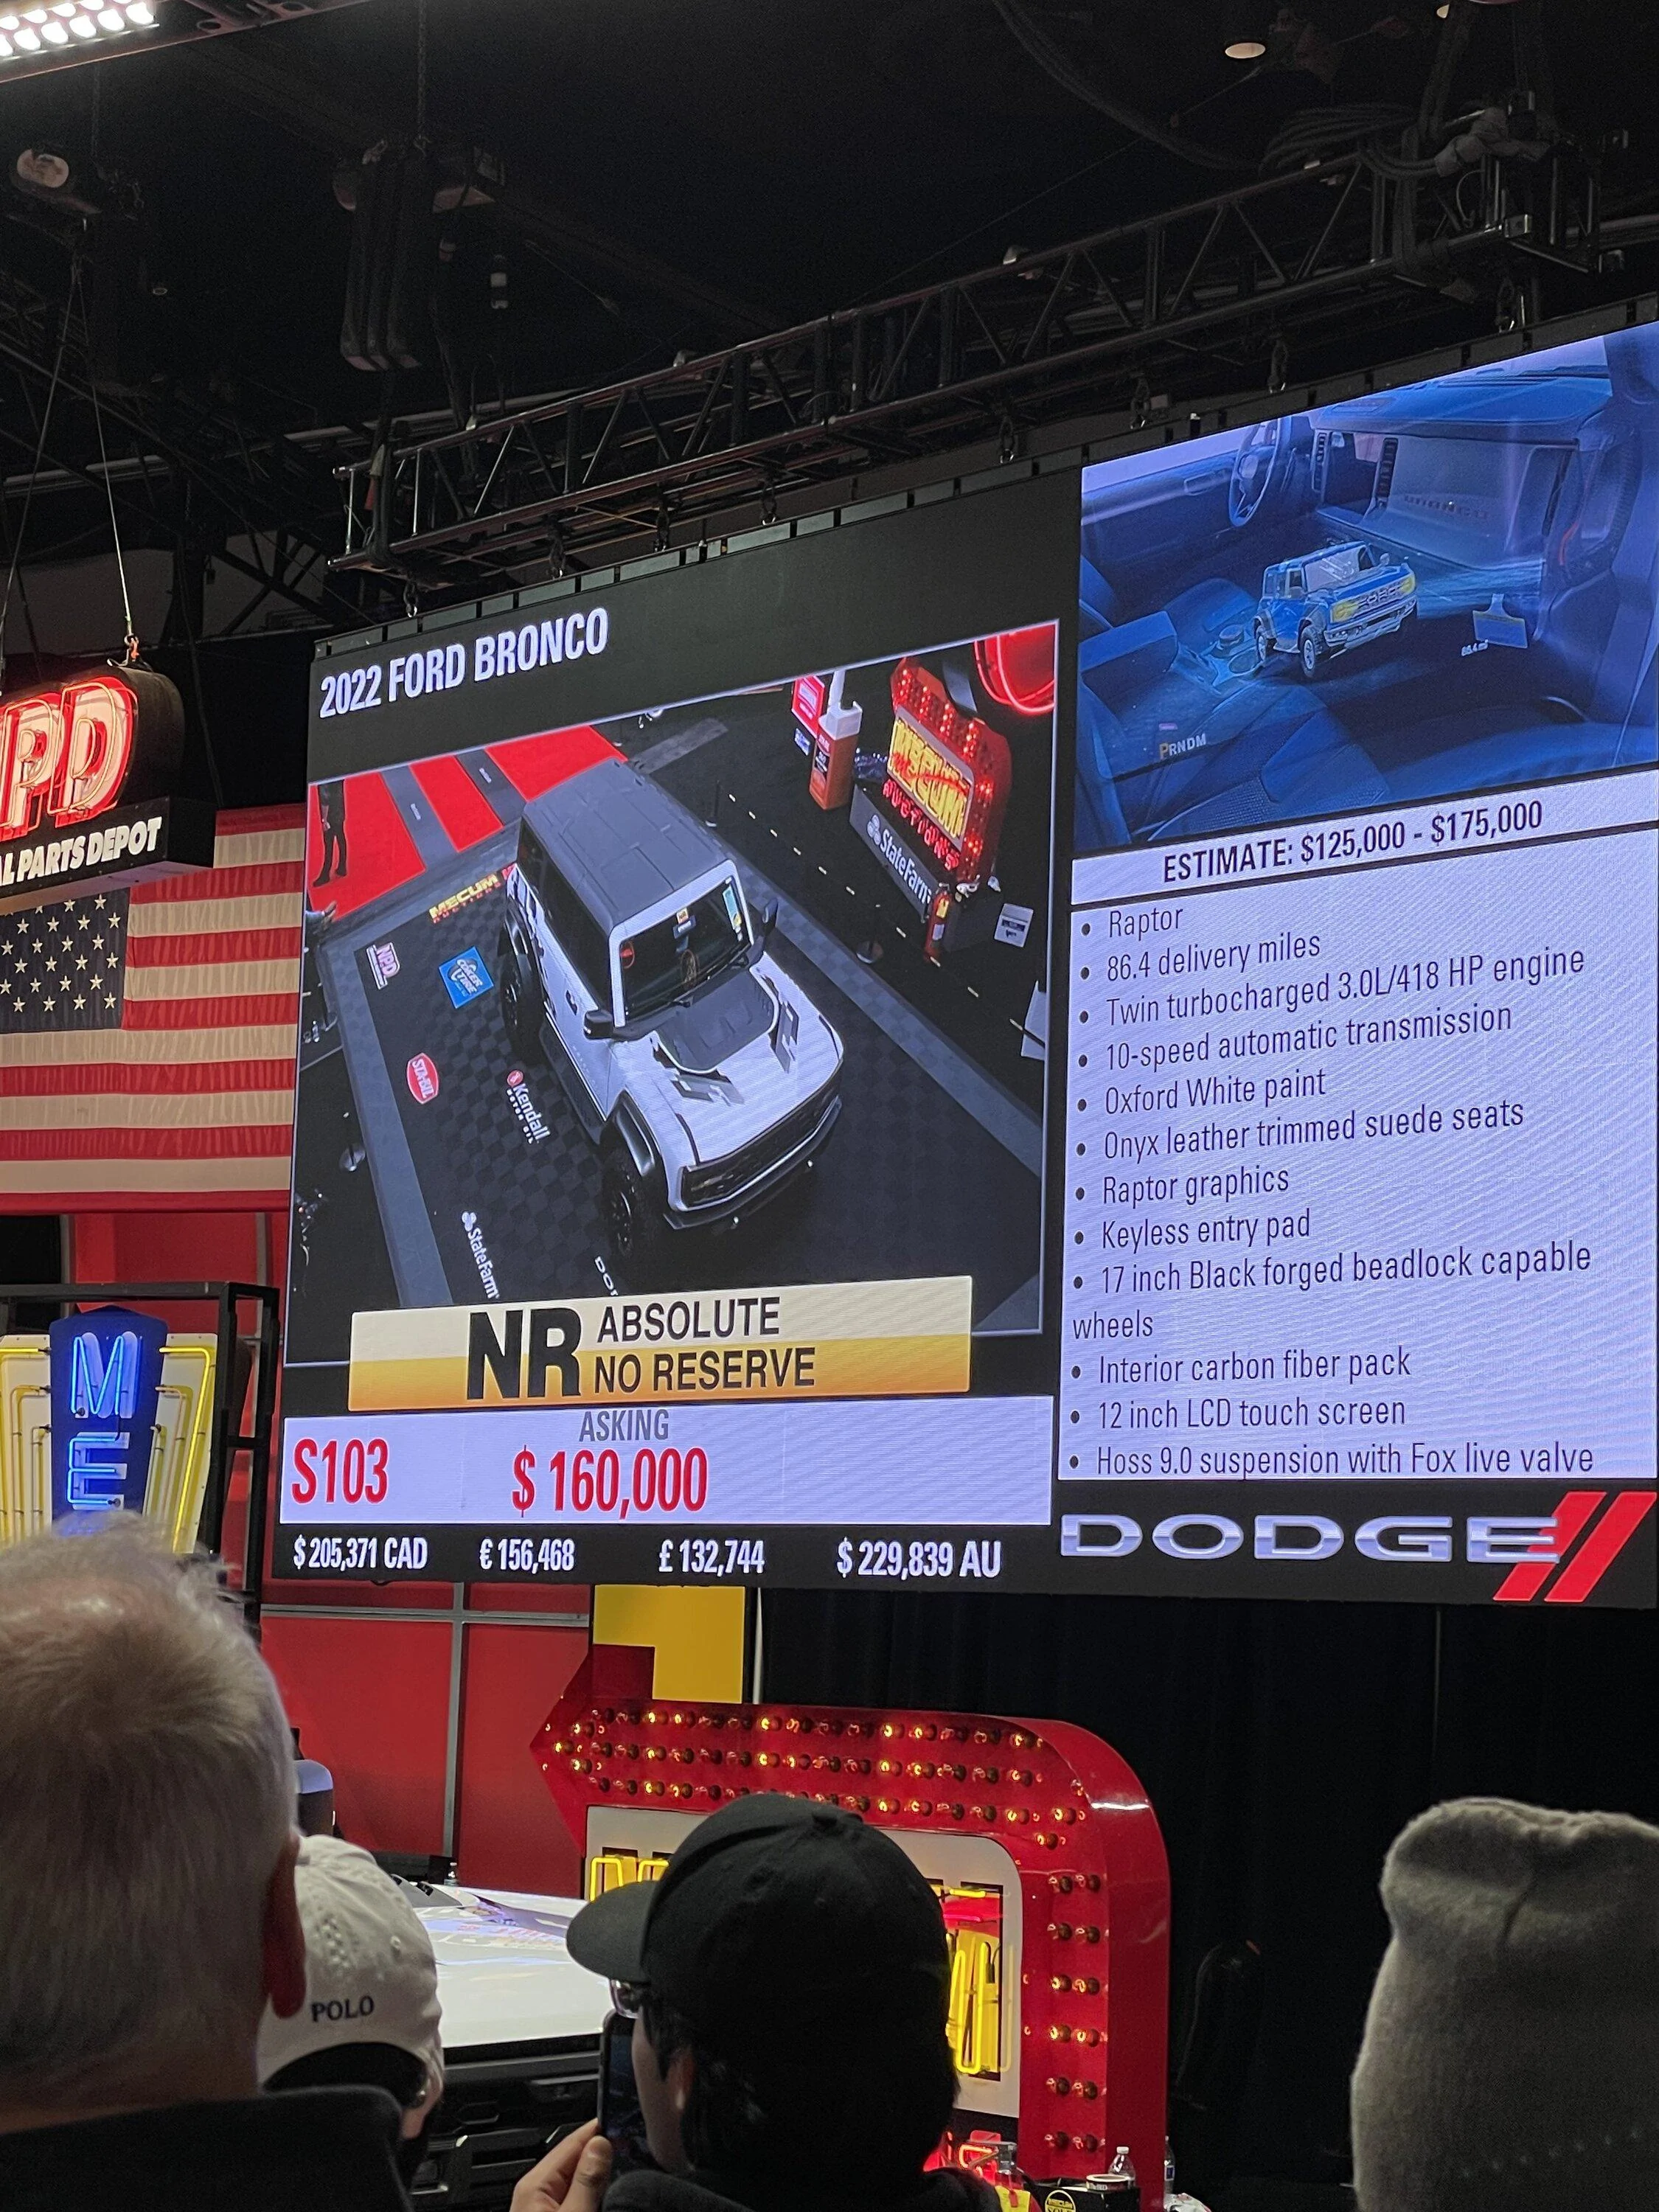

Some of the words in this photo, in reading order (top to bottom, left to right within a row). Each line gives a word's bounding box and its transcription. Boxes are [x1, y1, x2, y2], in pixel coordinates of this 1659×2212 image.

[319, 664, 382, 718] 2022
[389, 643, 466, 702] FORD
[474, 608, 608, 682] BRONCO
[1159, 733, 1206, 760] PRNDM
[16, 835, 86, 883] PARTS
[86, 816, 162, 866] DEPOT
[1164, 838, 1293, 883] ESTIMATE:
[1301, 821, 1405, 865] $125,000
[1430, 800, 1543, 846] $175,000
[429, 874, 498, 919] MECUM
[1109, 908, 1183, 942] Raptor
[1107, 951, 1150, 982] 86.4
[1158, 942, 1251, 977] delivery
[1259, 931, 1321, 964] miles
[1106, 995, 1159, 1026] Twin
[1166, 973, 1329, 1019] turbocharged
[1338, 961, 1439, 1000] 3.0L/418
[1450, 954, 1484, 987] HP
[1493, 946, 1585, 986] engine
[1107, 1032, 1209, 1073] 10-speed
[1218, 1020, 1338, 1059] automatic
[1346, 1002, 1511, 1046] transmission
[512, 1083, 551, 1140] Kendall
[1105, 1080, 1178, 1115] Oxford
[1186, 1075, 1256, 1107] White
[1265, 1068, 1326, 1108] paint
[1105, 1131, 1159, 1164] Onyx
[1167, 1122, 1251, 1155] leather
[1256, 1110, 1355, 1147] trimmed
[1365, 1103, 1442, 1138] suede
[1452, 1099, 1523, 1131] seats
[1103, 1176, 1178, 1210] Raptor
[1186, 1164, 1289, 1206] graphics
[1102, 1218, 1189, 1254] Keyless
[1197, 1215, 1259, 1248] entry
[1267, 1207, 1310, 1247] pad
[1102, 1265, 1124, 1293] 17
[1133, 1262, 1180, 1293] inch
[1190, 1257, 1256, 1290] Black
[1262, 1252, 1343, 1292] forged
[1353, 1245, 1472, 1281] beadlock
[1481, 1239, 1590, 1281] capable
[597, 1296, 780, 1343] ABSOLUTE
[1073, 1309, 1153, 1340] wheels
[467, 1307, 582, 1400] NR
[594, 1354, 641, 1394] NO
[653, 1347, 815, 1391] RESERVE
[1100, 1354, 1183, 1384] Interior
[1192, 1351, 1274, 1381] carbon
[1283, 1349, 1340, 1379] fiber
[1349, 1345, 1411, 1385] pack
[579, 1408, 669, 1442] ASKING
[1099, 1402, 1122, 1429] 12
[1130, 1399, 1178, 1428] inch
[1188, 1398, 1231, 1427] LCD
[1239, 1397, 1308, 1427] touch
[1318, 1402, 1405, 1425] screen
[291, 1438, 389, 1504] S103
[1098, 1446, 1152, 1475] Hoss
[1160, 1446, 1192, 1475] 9.0
[1200, 1444, 1339, 1478] suspension
[1348, 1442, 1401, 1473] with
[1412, 1442, 1456, 1473] Fox
[1466, 1441, 1510, 1472] live
[1520, 1441, 1593, 1472] valve
[383, 1537, 428, 1570] CAD
[959, 1540, 1002, 1578] AU
[1060, 1514, 1561, 1563] DODGE
[311, 1994, 375, 2023] POLO
